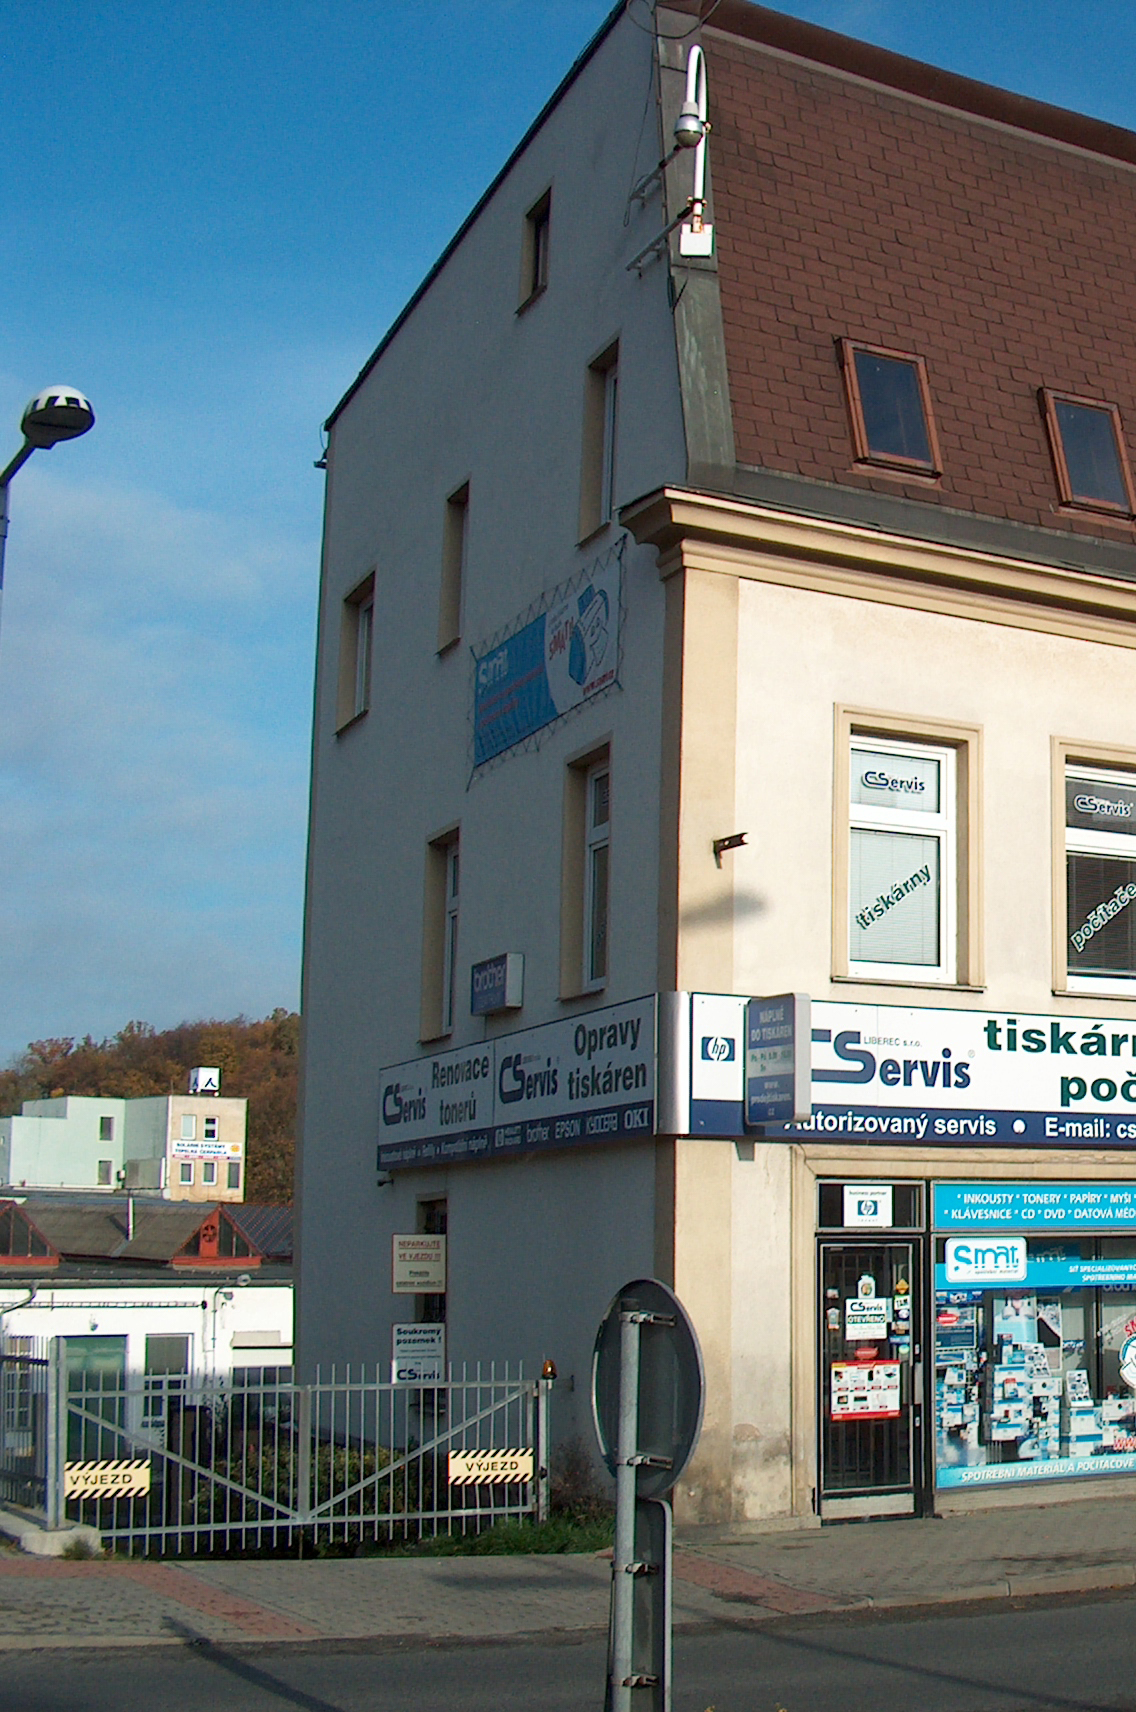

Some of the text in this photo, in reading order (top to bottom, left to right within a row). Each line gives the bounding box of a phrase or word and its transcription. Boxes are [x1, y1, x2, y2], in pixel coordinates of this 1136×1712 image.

[856, 864, 931, 929] tiskárny
[574, 1017, 642, 1060] Opravy
[750, 1029, 760, 1041] DO
[863, 1036, 901, 1046] LIBEREC
[432, 1054, 490, 1090] Renovace
[567, 1062, 647, 1100] tiskáren
[439, 1093, 477, 1126] tonerů
[624, 1107, 649, 1130] OKI
[554, 1118, 582, 1139] EPSON
[934, 1116, 997, 1136] servis
[1045, 1117, 1112, 1139] E-mail:
[963, 1191, 1131, 1204] INKOUSTY TONERY PAPÍRY MYŠI
[951, 1206, 1012, 1219] KLÁVESNICE
[1021, 1208, 1036, 1219] CD
[1044, 1208, 1065, 1219] DVD
[1074, 1206, 1113, 1219] DATOVÁ
[466, 1459, 520, 1472] VÝJEZD
[1018, 1463, 1065, 1478] MATERIÁL
[1067, 1464, 1075, 1474] A
[69, 1470, 134, 1485] VÝJEZD
